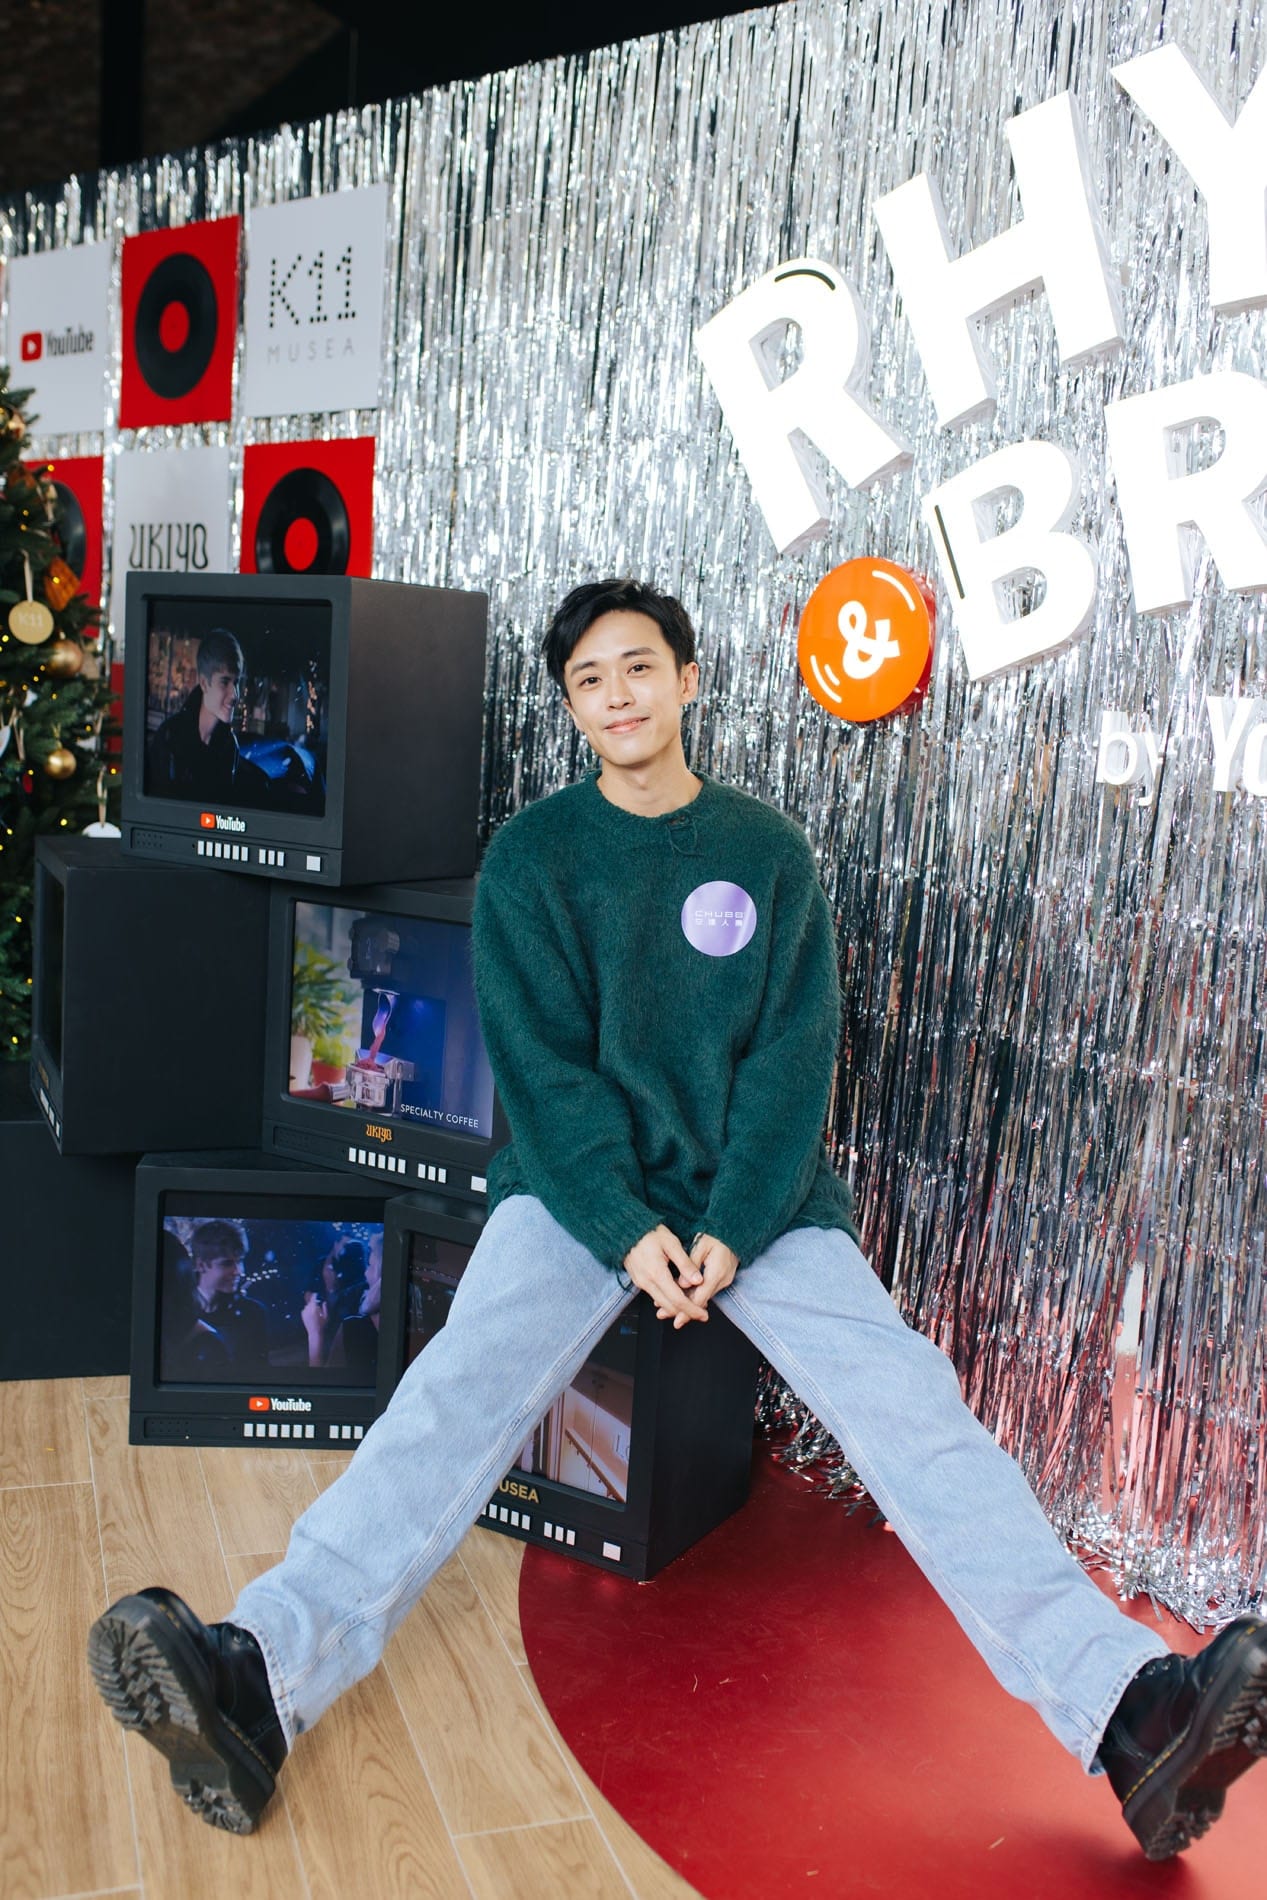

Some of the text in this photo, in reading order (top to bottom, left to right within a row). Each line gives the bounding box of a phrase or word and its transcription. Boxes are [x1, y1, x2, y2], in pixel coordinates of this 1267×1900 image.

[269, 245, 357, 329] K11
[46, 325, 95, 357] YouTube
[266, 336, 356, 365] MUSEA
[129, 522, 209, 573] UKIYO
[837, 600, 900, 681] &
[1096, 711, 1174, 807] by
[215, 814, 246, 833] YouTube
[400, 1103, 479, 1129] SPECIALTY COFFEE
[270, 1397, 312, 1412] YouTube
[499, 1479, 539, 1504] USEA
